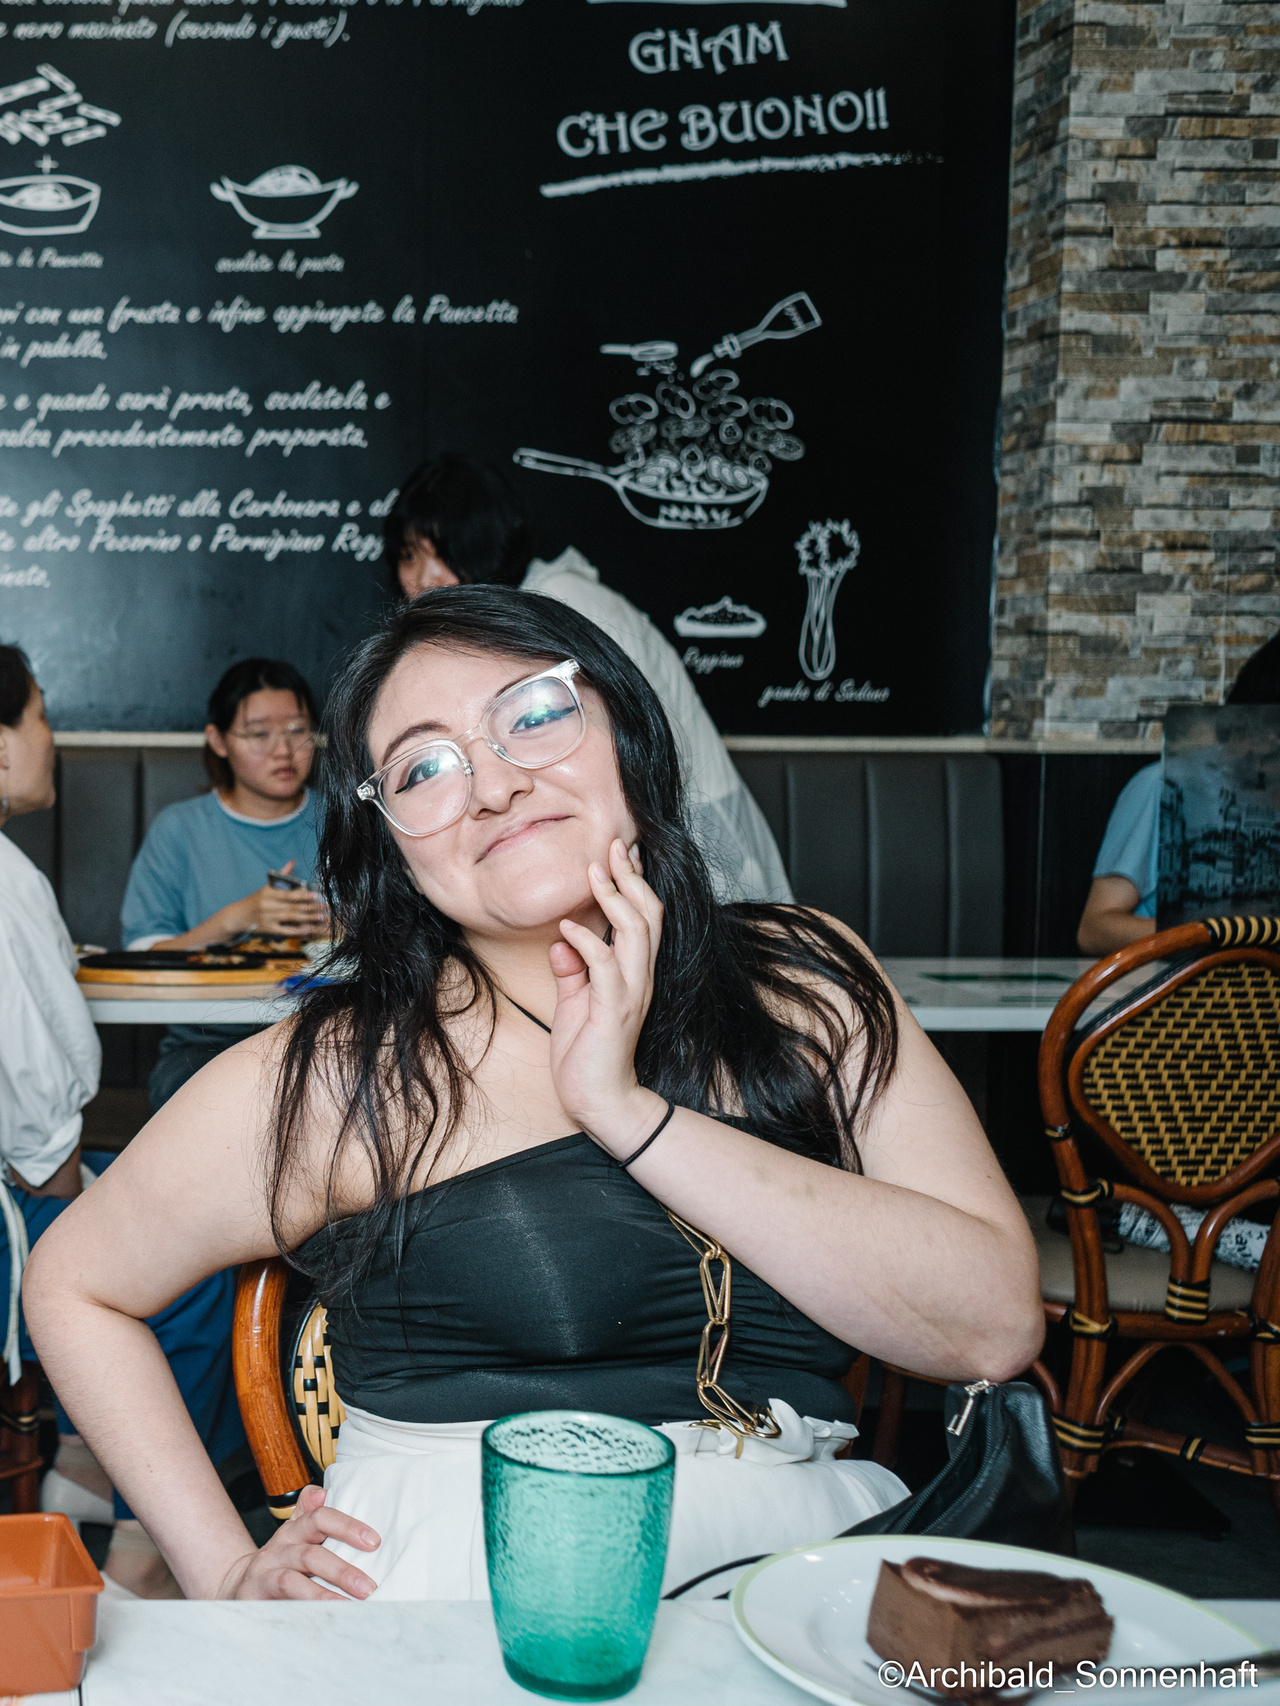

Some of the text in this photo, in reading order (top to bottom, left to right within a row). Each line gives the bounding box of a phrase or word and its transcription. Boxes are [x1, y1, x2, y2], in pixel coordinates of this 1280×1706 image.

[13, 21, 64, 40] nero
[67, 15, 158, 40] macinato
[260, 15, 278, 40] i
[628, 20, 789, 75] GNAM
[679, 86, 889, 151] BUONO!!
[24, 306, 62, 327] con
[67, 306, 105, 326] una
[107, 294, 181, 334] frusta
[185, 306, 203, 324] e
[206, 294, 268, 333] infine
[272, 299, 386, 334] aggiungete
[392, 294, 417, 324] la
[422, 294, 519, 325] Pancetta
[20, 329, 109, 369] padella.
[13, 393, 31, 411] e
[36, 382, 111, 423] quando
[115, 384, 172, 412] sarà
[168, 385, 253, 421] pronta,
[263, 379, 369, 412] scolatela
[374, 391, 392, 411] e
[51, 418, 246, 459] precedentemente
[243, 420, 369, 459] preparata.
[19, 488, 63, 529] gli
[64, 487, 176, 528] Spaghetti
[176, 488, 222, 519] alla
[228, 487, 342, 520] Carbonara
[345, 498, 364, 518] e
[22, 523, 81, 553] altro
[87, 523, 183, 553] Pecorino
[208, 523, 326, 563] Parmigiano
